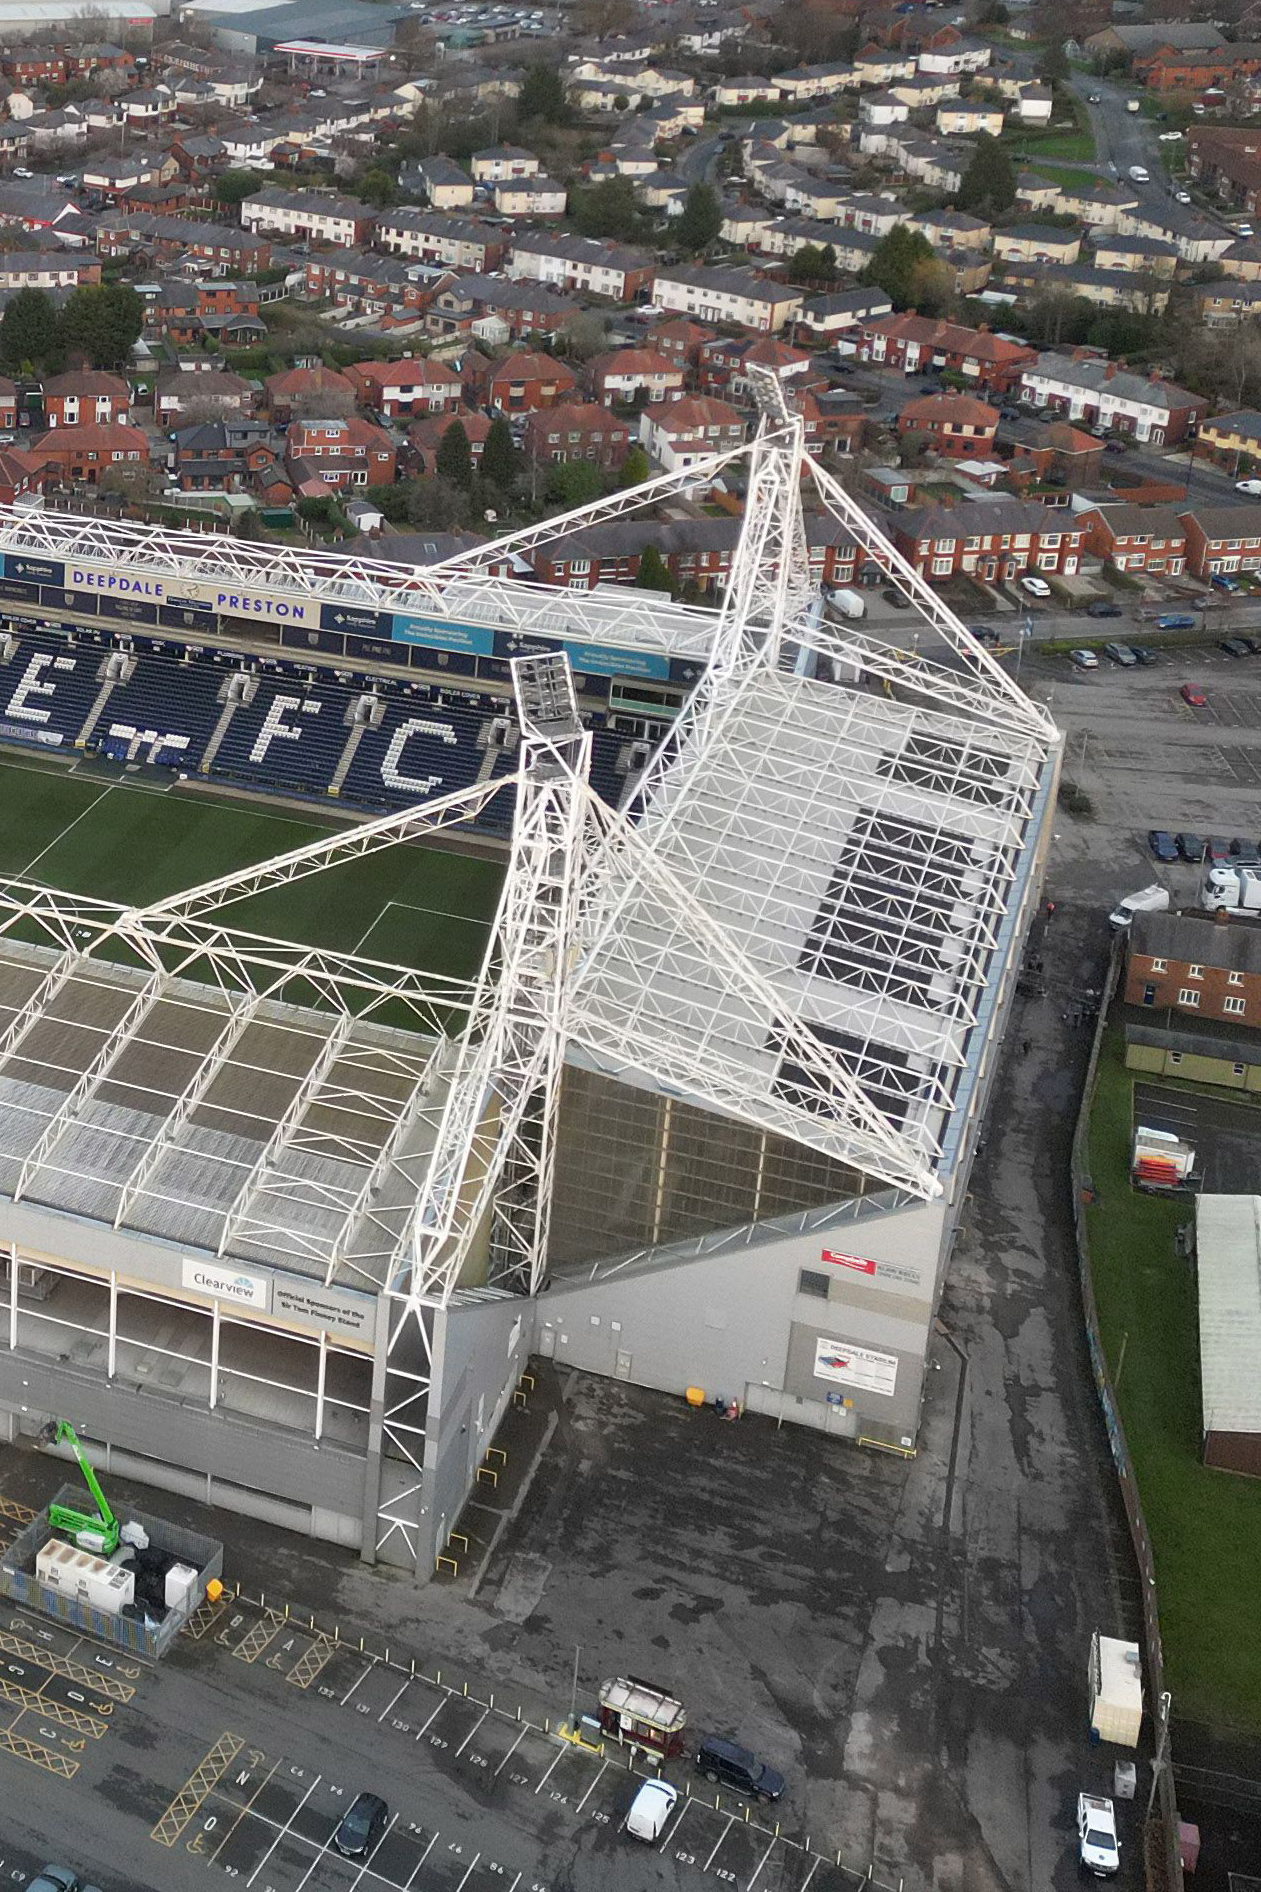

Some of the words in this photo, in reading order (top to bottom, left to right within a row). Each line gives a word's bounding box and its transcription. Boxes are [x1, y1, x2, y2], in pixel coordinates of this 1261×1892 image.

[73, 570, 164, 597] DEEPDALE
[218, 593, 305, 620] PRESTON
[194, 1273, 254, 1298] Clearview
[277, 1290, 304, 1303] Official
[306, 1298, 340, 1314] Sponsors
[342, 1308, 351, 1316] of
[352, 1311, 364, 1320] the
[292, 1304, 309, 1314] Tom
[310, 1309, 336, 1322] Finney
[338, 1317, 361, 1328] Stand
[37, 1629, 54, 1642] H
[282, 1638, 294, 1650] A
[95, 1654, 113, 1667] E
[8, 1664, 24, 1676] G
[318, 1686, 335, 1698] 132
[356, 1702, 370, 1714] 131
[392, 1719, 410, 1732] 130
[39, 1727, 56, 1739] C
[468, 1754, 488, 1768] 128
[235, 1770, 250, 1786] N
[510, 1772, 529, 1784] 127
[550, 1790, 568, 1805] 126
[592, 1810, 610, 1824] 125
[407, 1822, 423, 1834] 96
[447, 1842, 462, 1854] 97
[676, 1851, 695, 1865] 123
[224, 1864, 238, 1878] 92
[489, 1862, 504, 1875] 98
[716, 1868, 736, 1882] 122
[10, 1870, 26, 1882] 63
